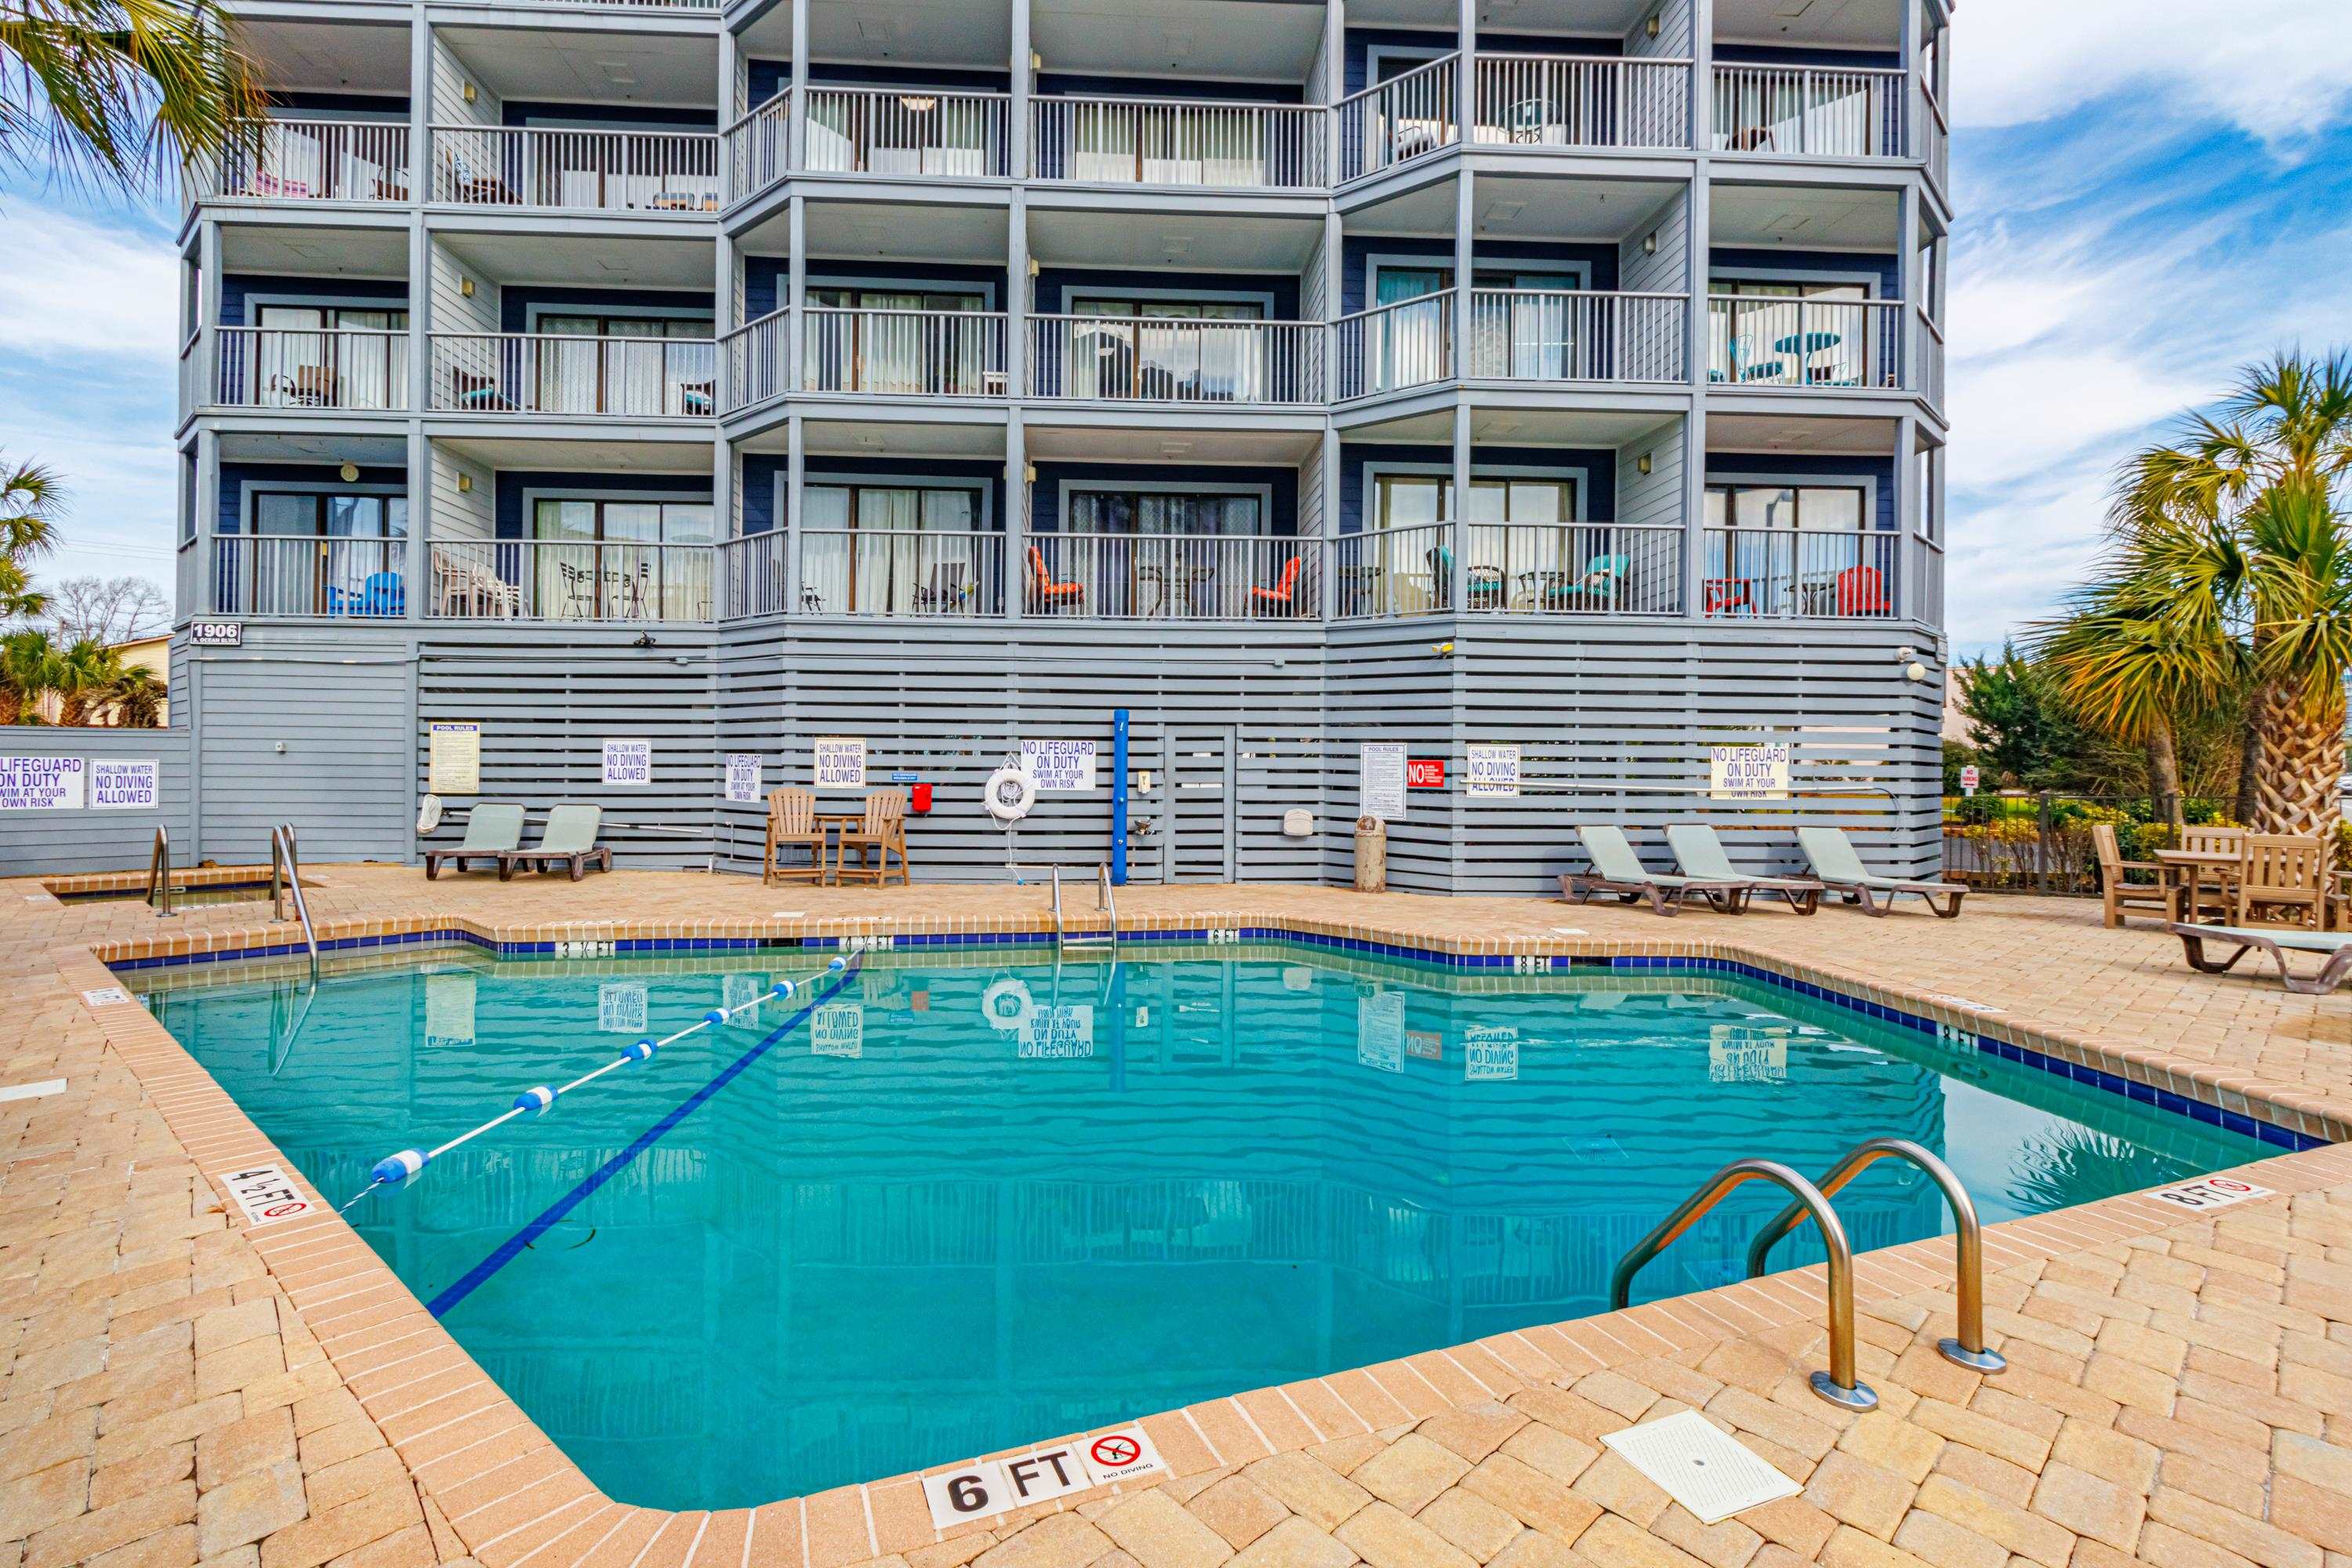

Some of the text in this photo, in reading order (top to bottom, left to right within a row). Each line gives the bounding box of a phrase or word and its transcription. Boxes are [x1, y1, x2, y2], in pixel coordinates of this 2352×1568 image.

[194, 624, 238, 637] 1906
[607, 744, 647, 753] SHALLOW WATER
[819, 743, 862, 753] SHALLOW WATER
[1022, 742, 1094, 755] NO LIFEGUARD
[607, 754, 647, 766] NO DIVING
[727, 755, 761, 768] NO LIFEGUARD
[819, 755, 862, 768] NO DIVING
[1472, 750, 1515, 760] SHALLOW WATER
[1712, 748, 1787, 762] NO LIFEGUARD
[0, 758, 82, 772] LIFEGUARD
[1036, 756, 1080, 769] ON DUTY
[1472, 762, 1515, 776] NO DIVING
[96, 764, 153, 775] SHALLOW WATER
[608, 768, 645, 780] ALLOWED
[734, 768, 753, 782] ON DUTY
[819, 770, 861, 782] ALLOWED
[1033, 769, 1083, 779] SWIM AT YOUR
[1408, 764, 1425, 784] NO
[1727, 763, 1772, 777] ON DUTY
[22, 773, 60, 787] DUTY
[96, 775, 153, 789] NO DIVING
[1040, 779, 1076, 789] OWN RISK
[1472, 777, 1514, 792] ALLOWED
[1723, 778, 1776, 788] SWIM AT YOUR
[0, 788, 67, 797] WIM AT YOUR
[96, 789, 152, 804] ALLOWED
[2, 797, 54, 808] OWN RISK
[1213, 929, 1238, 938] 6 FT
[1521, 956, 1550, 967] 8 FT
[232, 1170, 274, 1181] 4
[245, 1189, 295, 1207] FT
[2161, 1192, 2205, 1206] 8
[2180, 1185, 2235, 1202] FT
[1102, 1462, 1154, 1480] NO DIVING
[947, 1450, 1071, 1512] 6 FT
